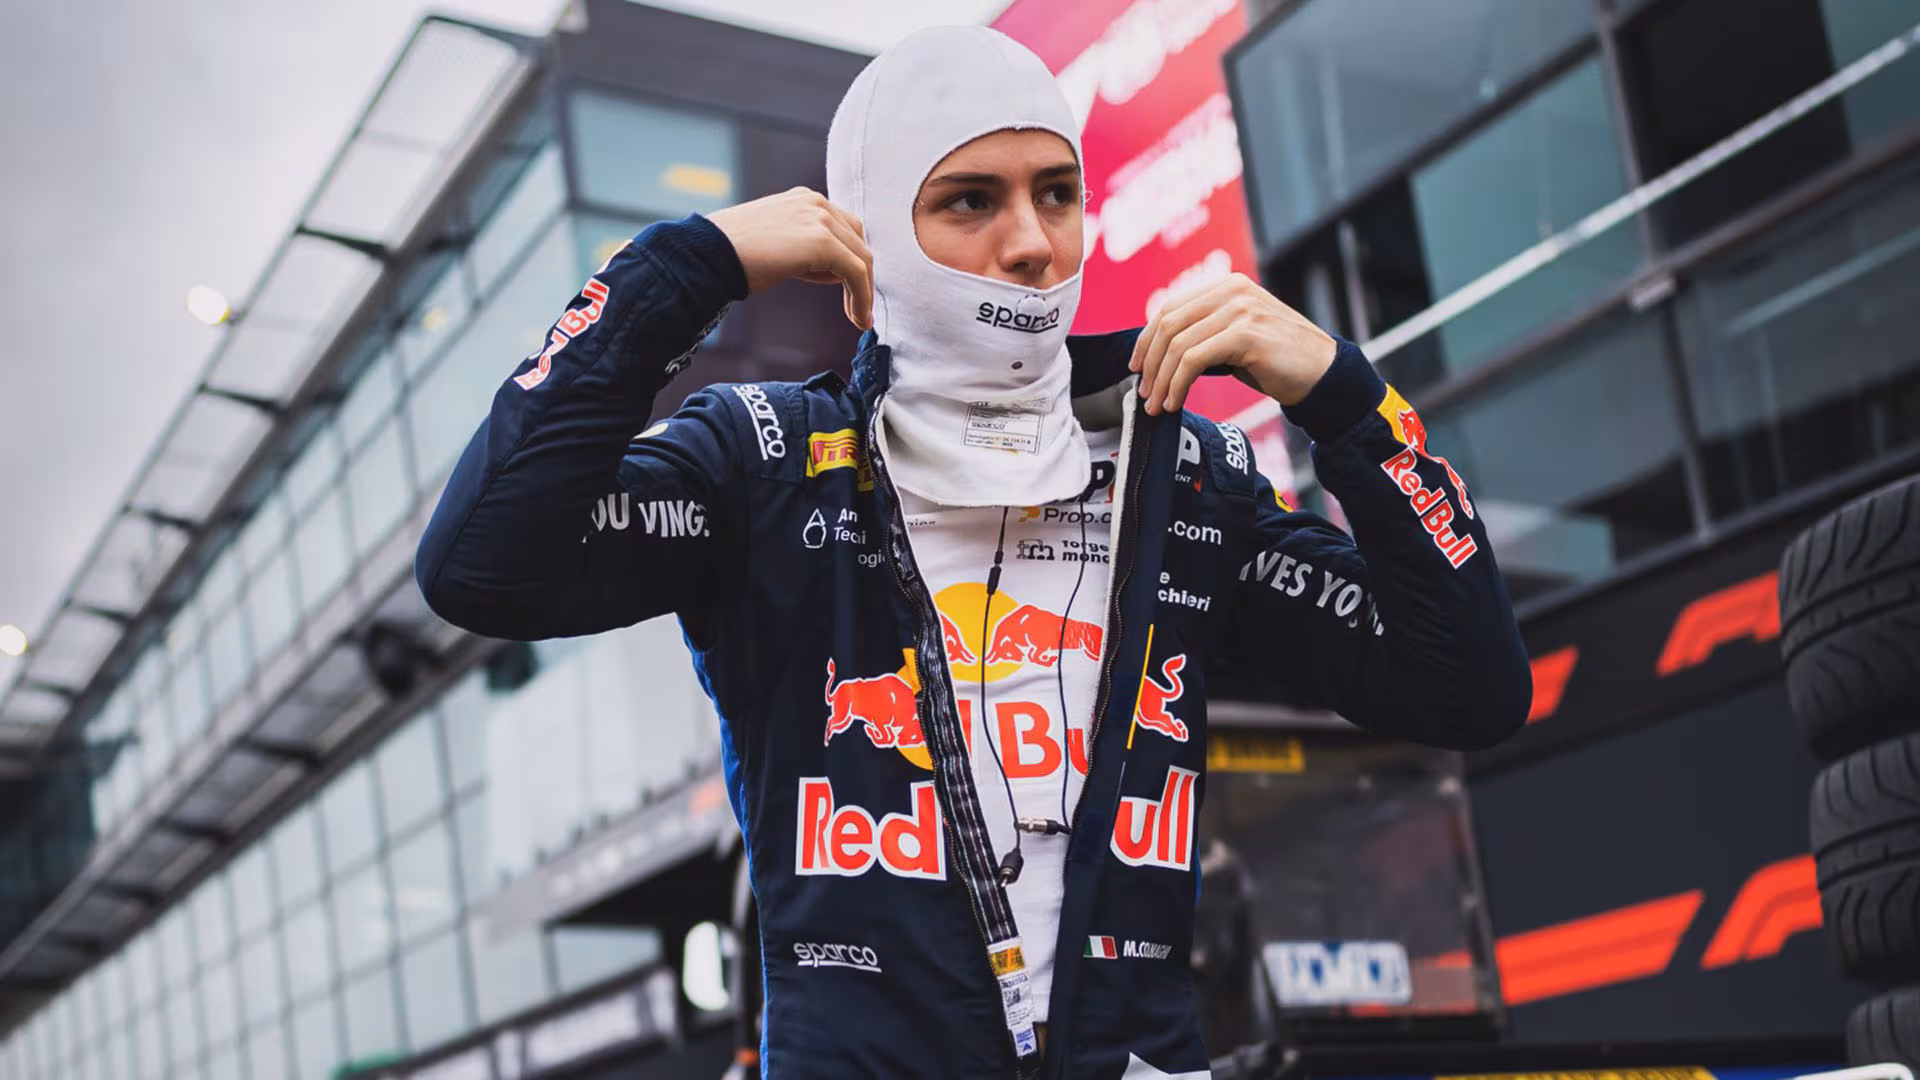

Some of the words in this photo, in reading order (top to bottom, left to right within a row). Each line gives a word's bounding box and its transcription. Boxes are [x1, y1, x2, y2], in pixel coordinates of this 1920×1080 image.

[976, 301, 1060, 333] sparco
[733, 383, 787, 461] sparco
[1167, 520, 1222, 545] .com
[796, 776, 947, 881] Red
[793, 941, 882, 973] sparco
